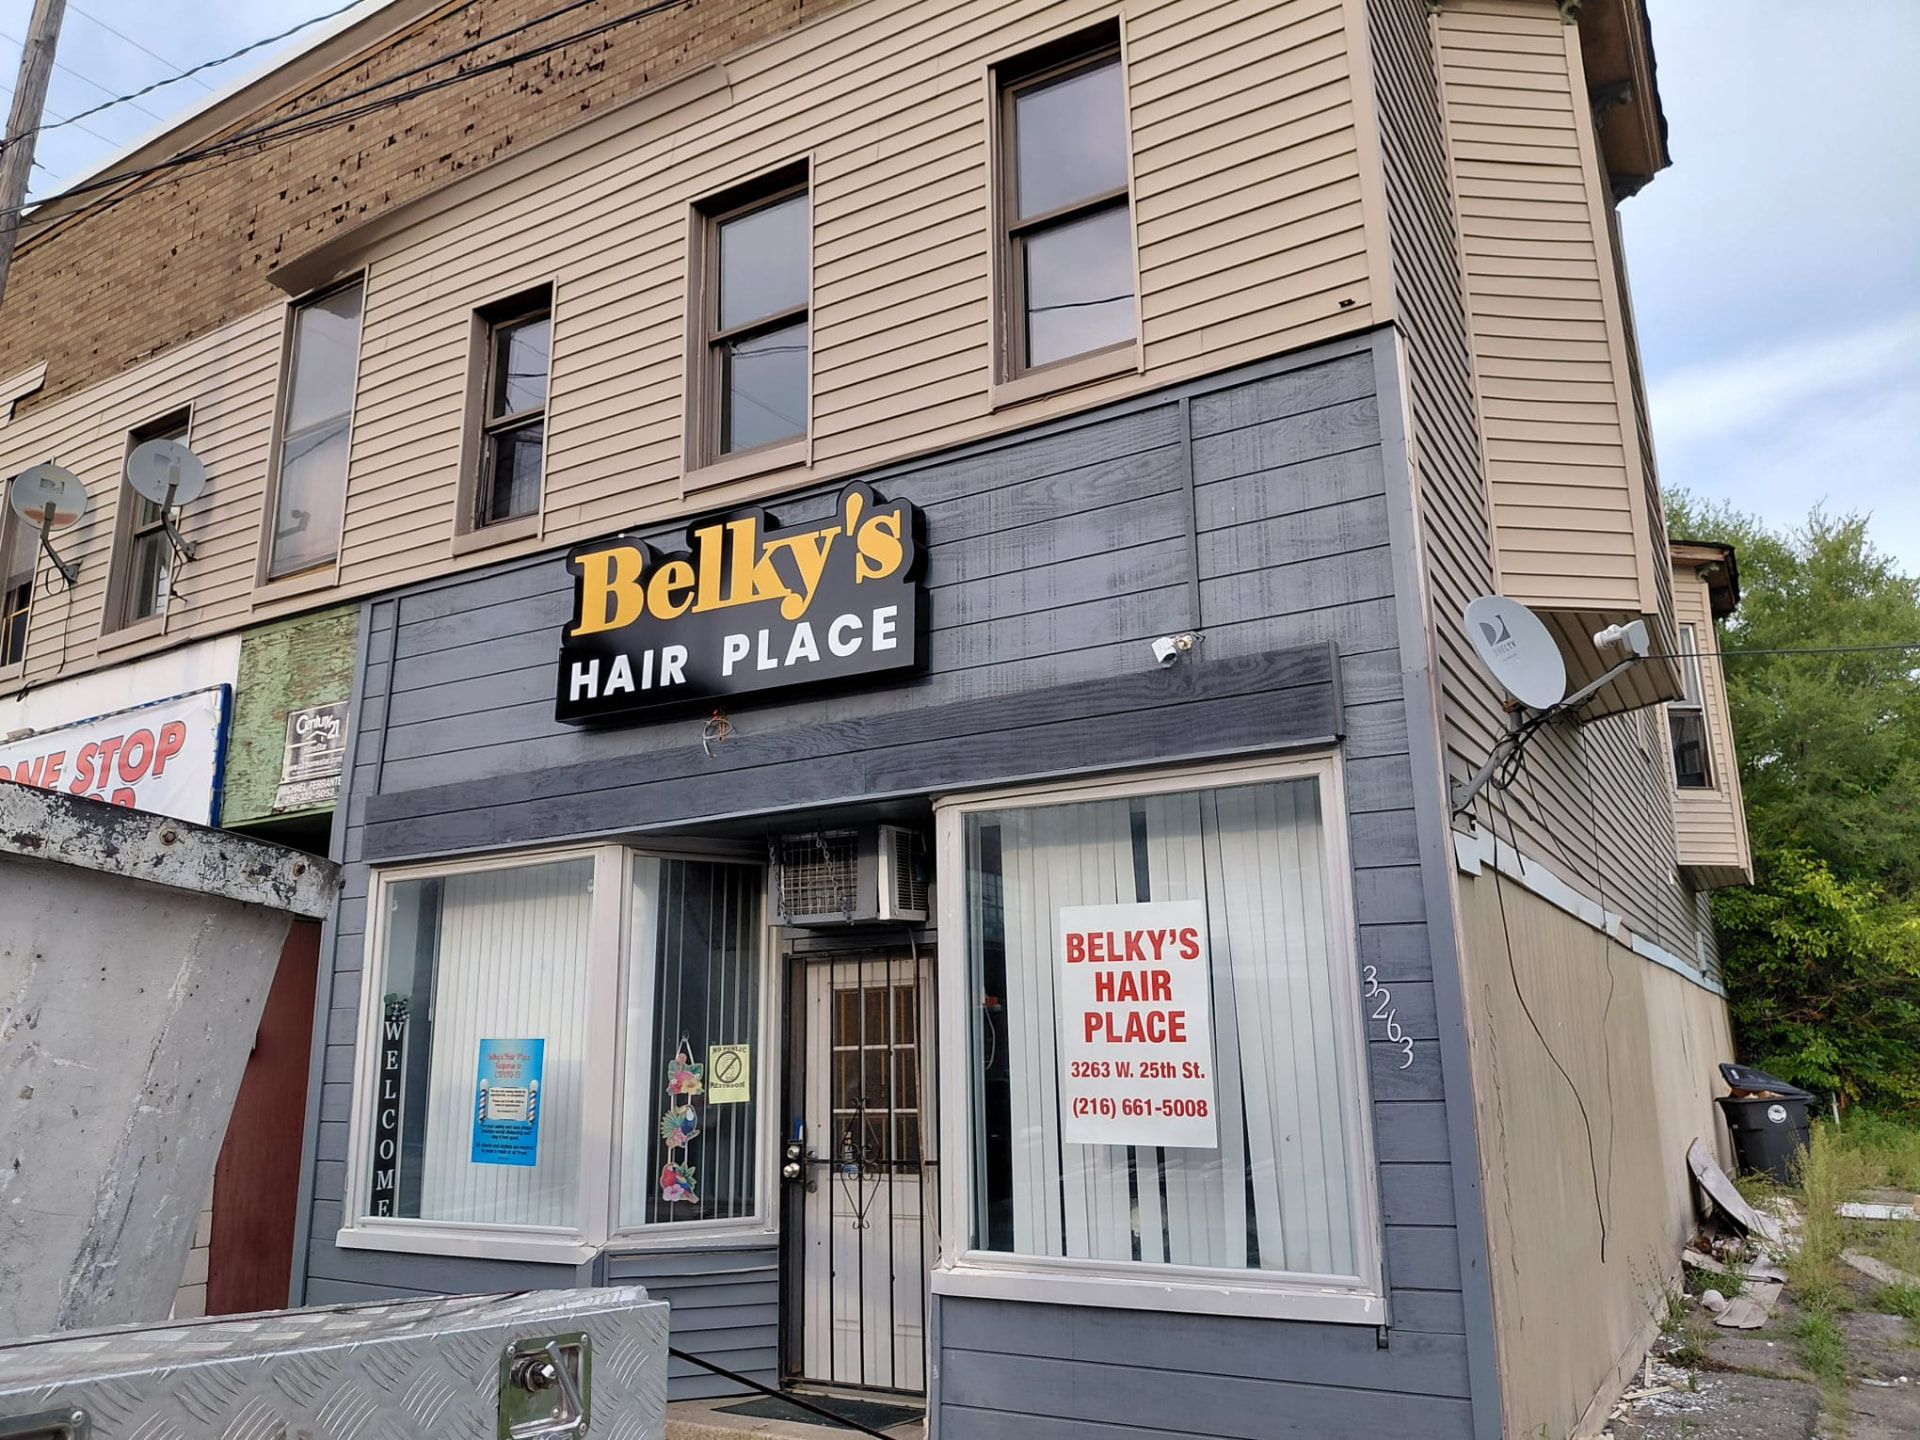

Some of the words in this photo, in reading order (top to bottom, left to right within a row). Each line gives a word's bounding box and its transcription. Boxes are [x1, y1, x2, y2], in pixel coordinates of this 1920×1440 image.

[570, 492, 904, 637] Belky's
[569, 644, 689, 702] HAIR
[722, 604, 898, 677] PLACE
[296, 715, 333, 735] Century
[327, 719, 341, 740] 21
[0, 750, 66, 791] NE
[69, 720, 187, 795] STOP
[1066, 927, 1200, 963] BELKY'S
[1094, 970, 1172, 1003] HAIR
[1084, 1010, 1187, 1044] PLACE
[1363, 964, 1414, 1070] 3263
[1071, 1061, 1110, 1079] 3263
[1115, 1061, 1134, 1079] W.
[1140, 1061, 1176, 1079] 25th
[1182, 1062, 1205, 1080] St.
[376, 1021, 404, 1217] WELCOME
[1072, 1097, 1116, 1119] (216)
[1122, 1098, 1208, 1118] 661-5008
